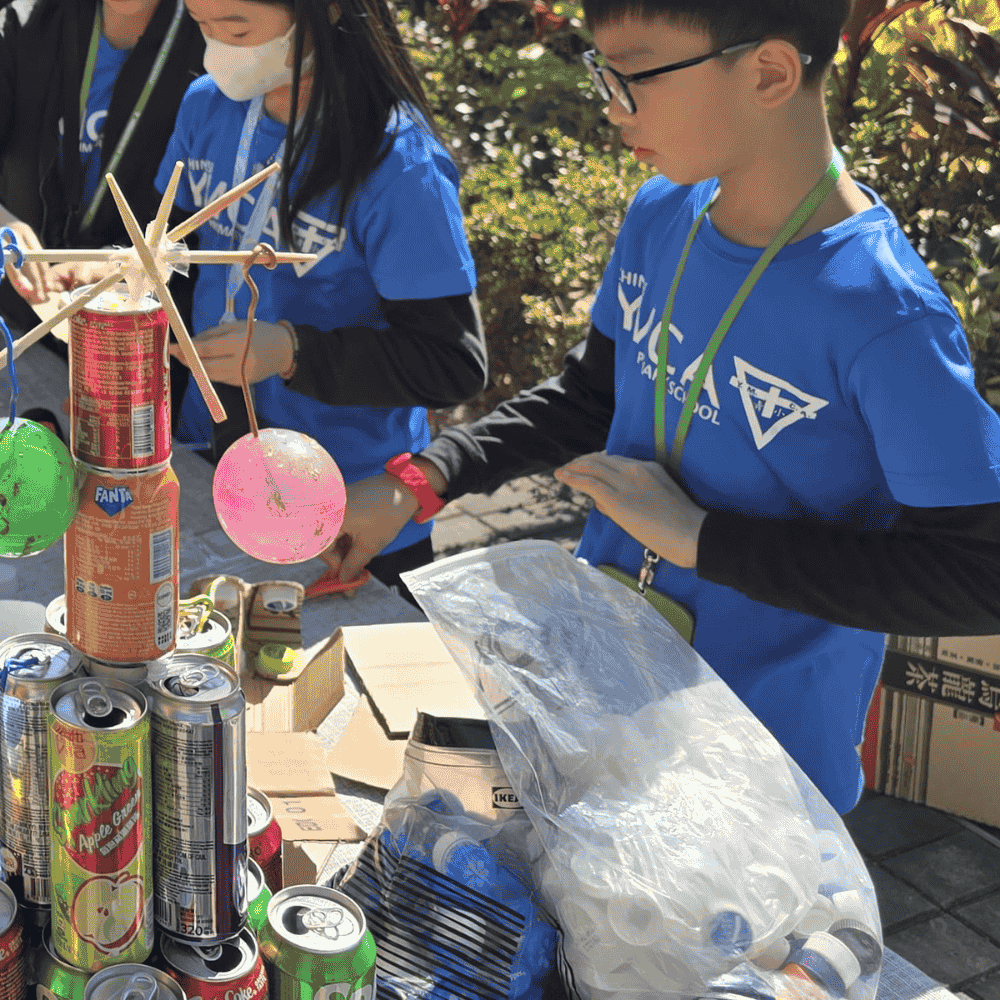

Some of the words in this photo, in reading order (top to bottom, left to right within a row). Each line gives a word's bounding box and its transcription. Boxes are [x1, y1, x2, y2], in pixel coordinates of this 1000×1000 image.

[94, 485, 133, 503] FANTA
[79, 824, 113, 854] Apple
[180, 923, 203, 937] 320
